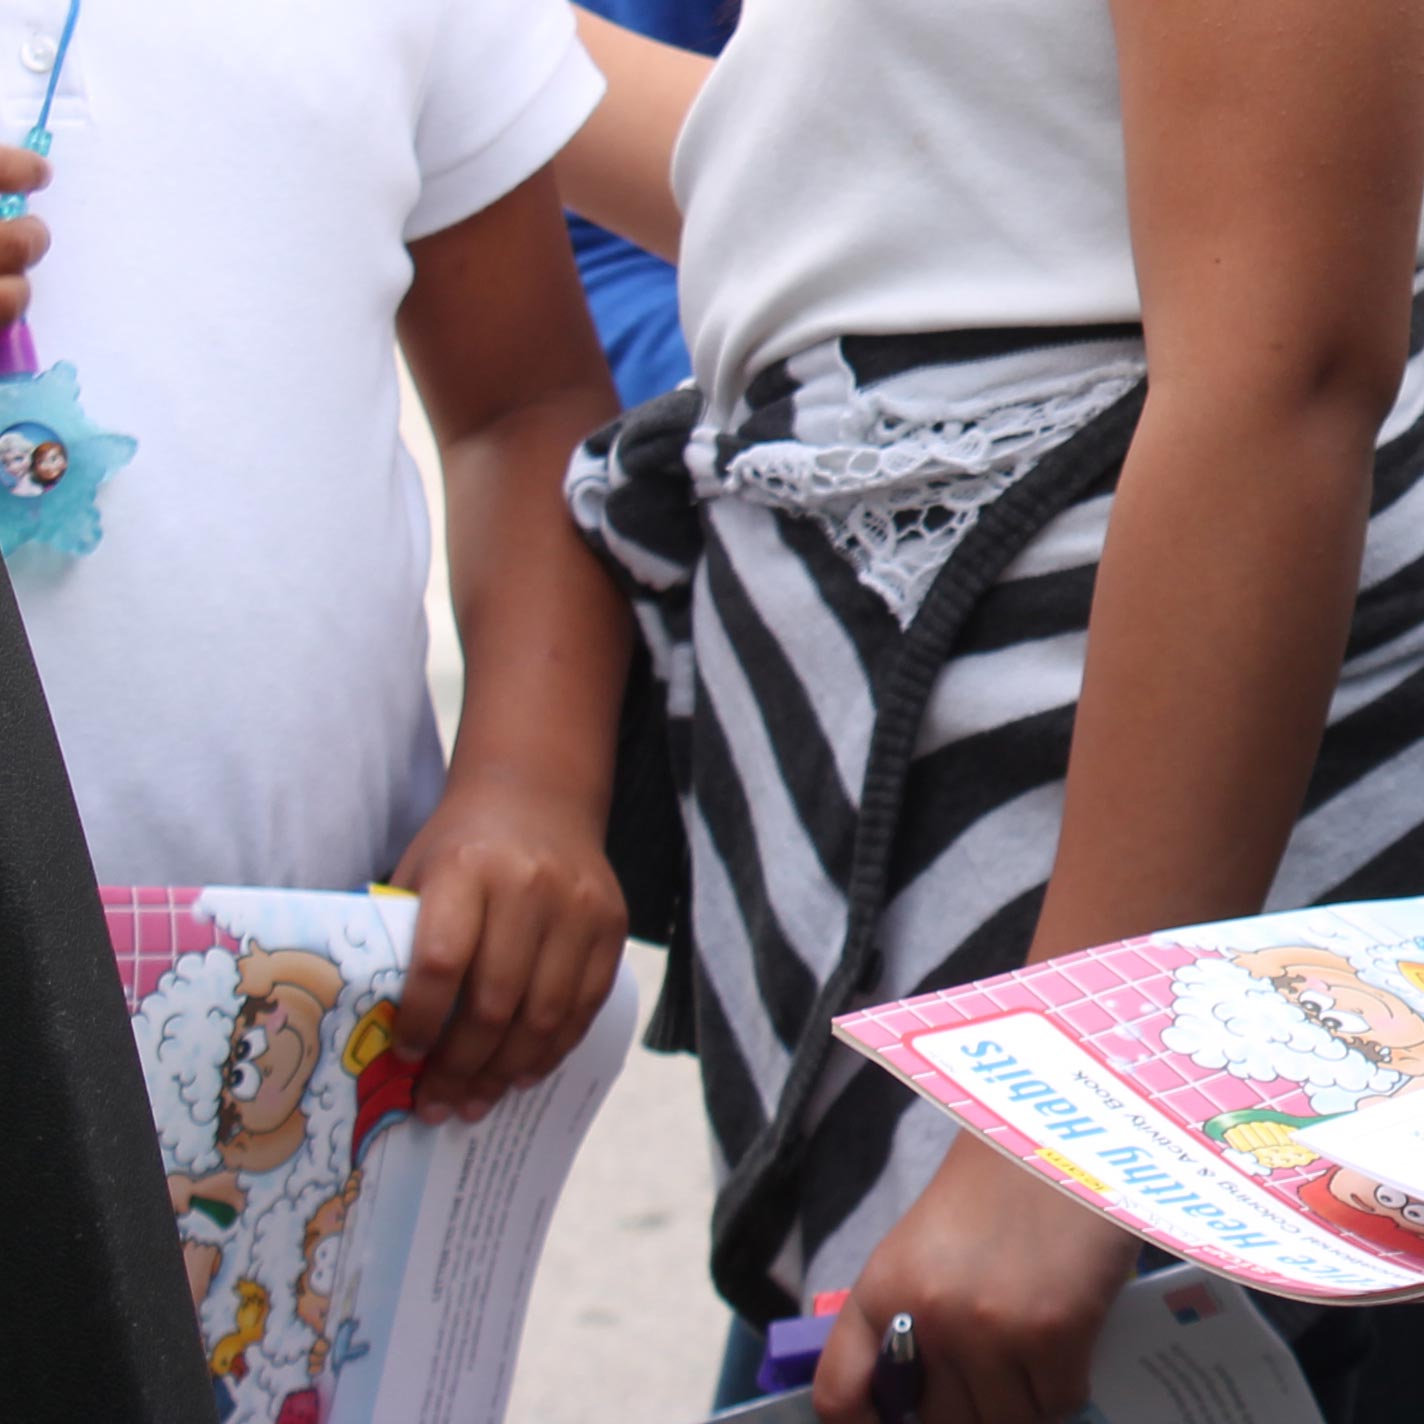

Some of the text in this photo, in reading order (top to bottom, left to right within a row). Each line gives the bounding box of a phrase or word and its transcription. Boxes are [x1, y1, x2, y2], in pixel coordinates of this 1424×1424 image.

[960, 1039, 1106, 1153] Habits
[1071, 1069, 1126, 1114] Book
[1124, 1113, 1200, 1167] Activity
[1096, 1145, 1279, 1249] Healthy
[1195, 1166, 1217, 1179] &
[1216, 1178, 1302, 1236] Coloring
